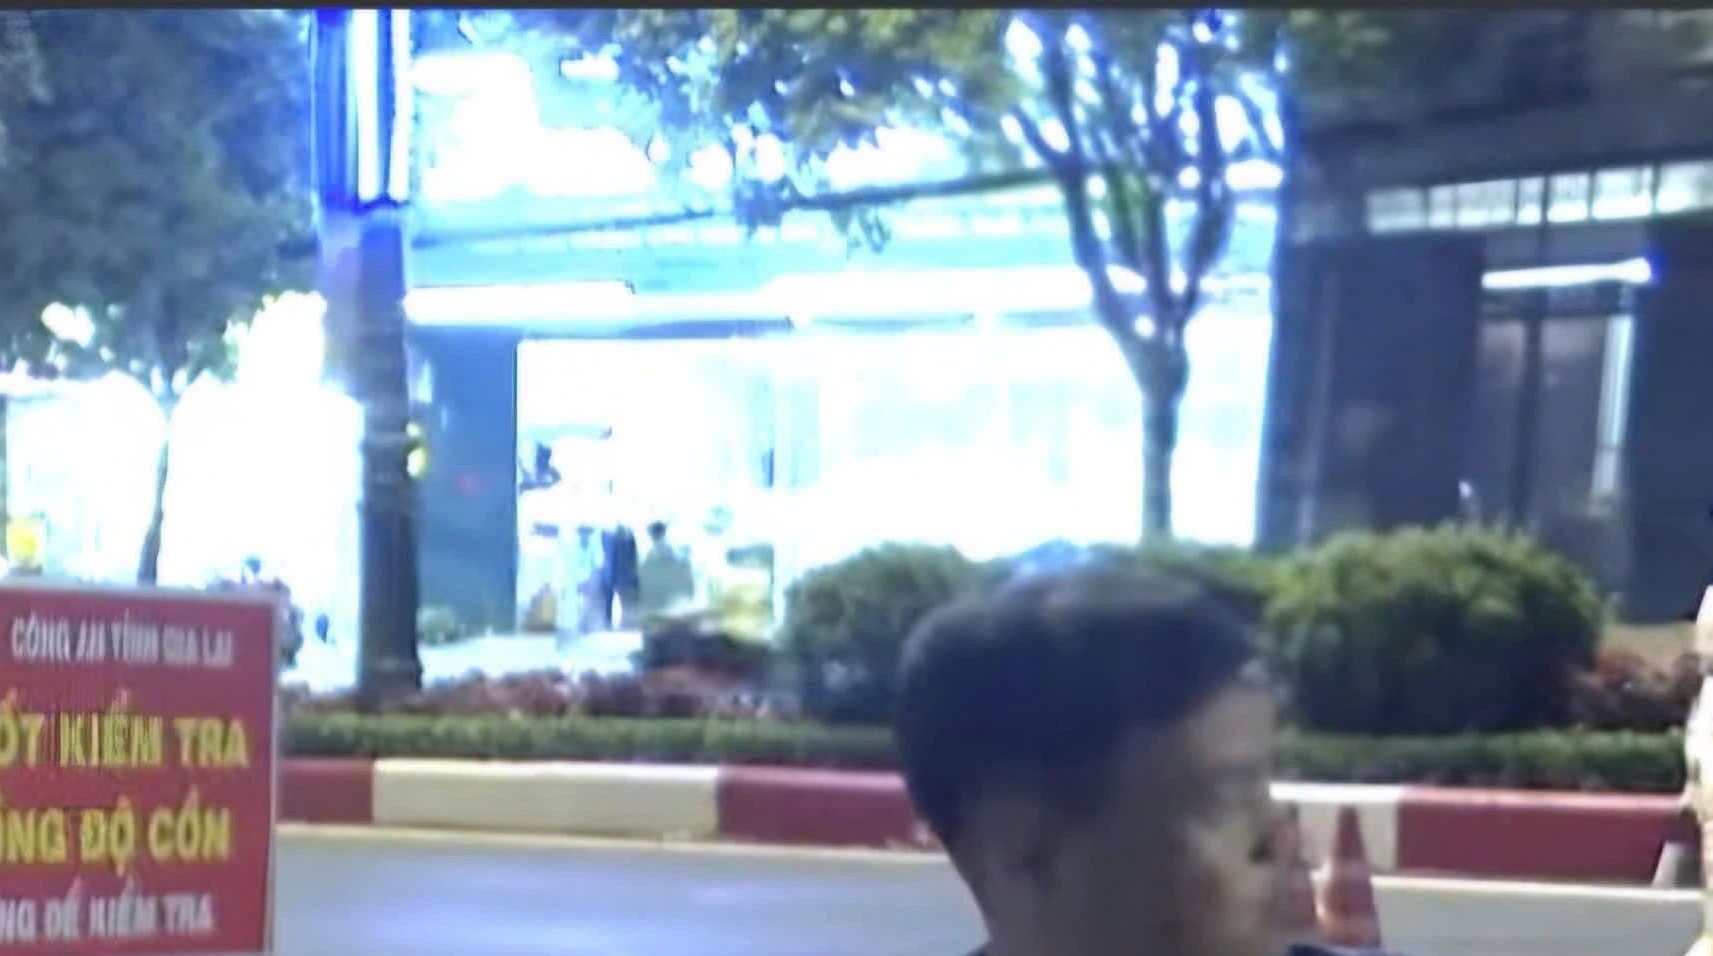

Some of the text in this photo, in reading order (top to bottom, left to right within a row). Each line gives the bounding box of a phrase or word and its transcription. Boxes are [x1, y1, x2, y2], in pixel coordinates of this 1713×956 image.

[11, 611, 70, 663] CÔNG
[76, 617, 106, 663] AN
[163, 623, 198, 667] GIA
[202, 624, 233, 669] LAI
[173, 715, 249, 769] TRA
[80, 794, 136, 878] ĐỘ
[162, 893, 214, 935] TRA
